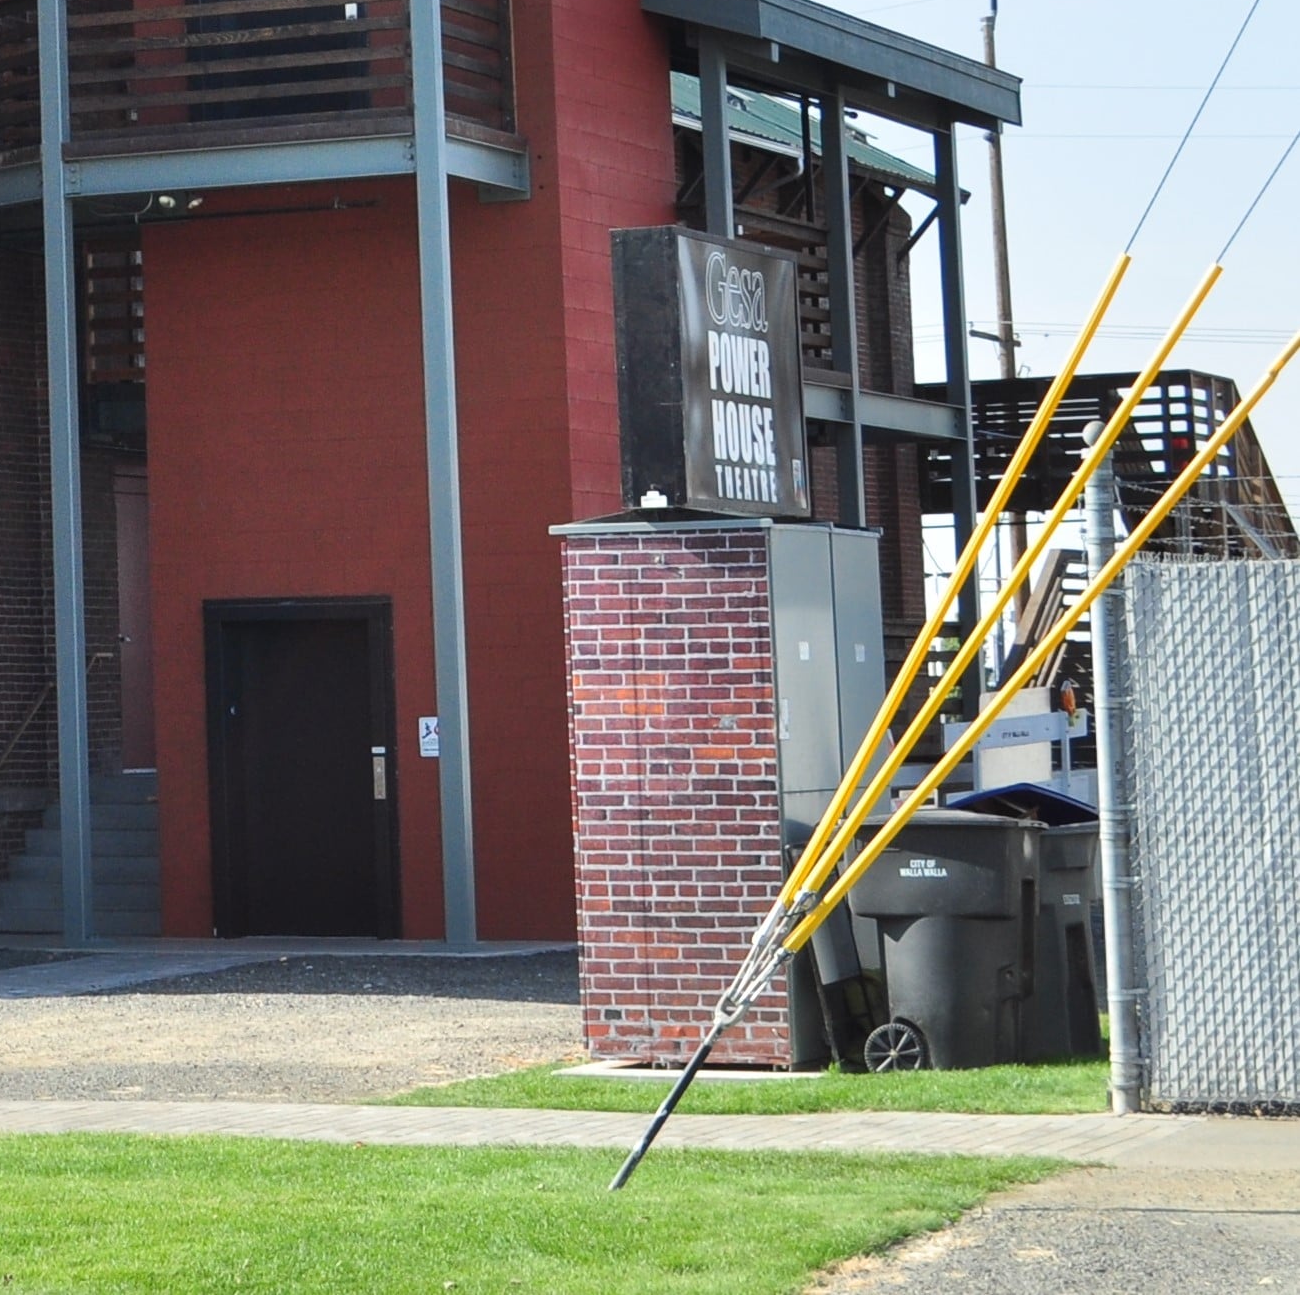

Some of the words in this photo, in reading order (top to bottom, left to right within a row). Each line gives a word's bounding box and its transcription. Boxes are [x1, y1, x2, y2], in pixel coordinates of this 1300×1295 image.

[705, 251, 768, 333] Gesa
[708, 330, 772, 399] POWER
[711, 398, 776, 466] HOUSE
[715, 464, 778, 504] THEATRE
[899, 868, 923, 877] WALLA
[923, 867, 948, 877] WALLA
[910, 859, 926, 868] CITY
[926, 859, 936, 868] OF
